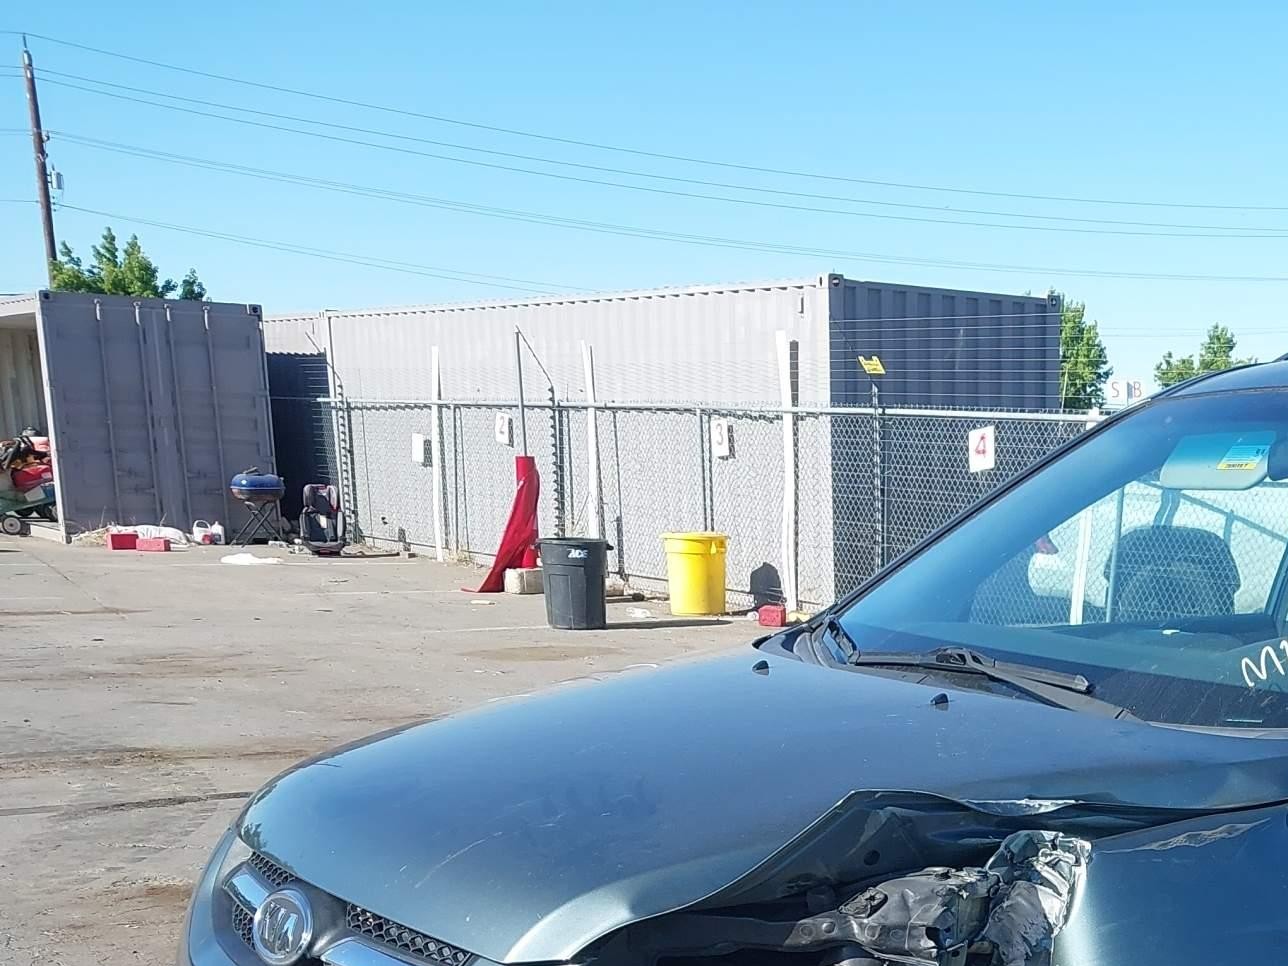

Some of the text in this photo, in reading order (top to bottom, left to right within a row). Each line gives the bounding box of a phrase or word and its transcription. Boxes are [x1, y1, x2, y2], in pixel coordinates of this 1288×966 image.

[716, 423, 724, 446] 3
[975, 433, 987, 458] 4
[568, 549, 589, 559] ACE
